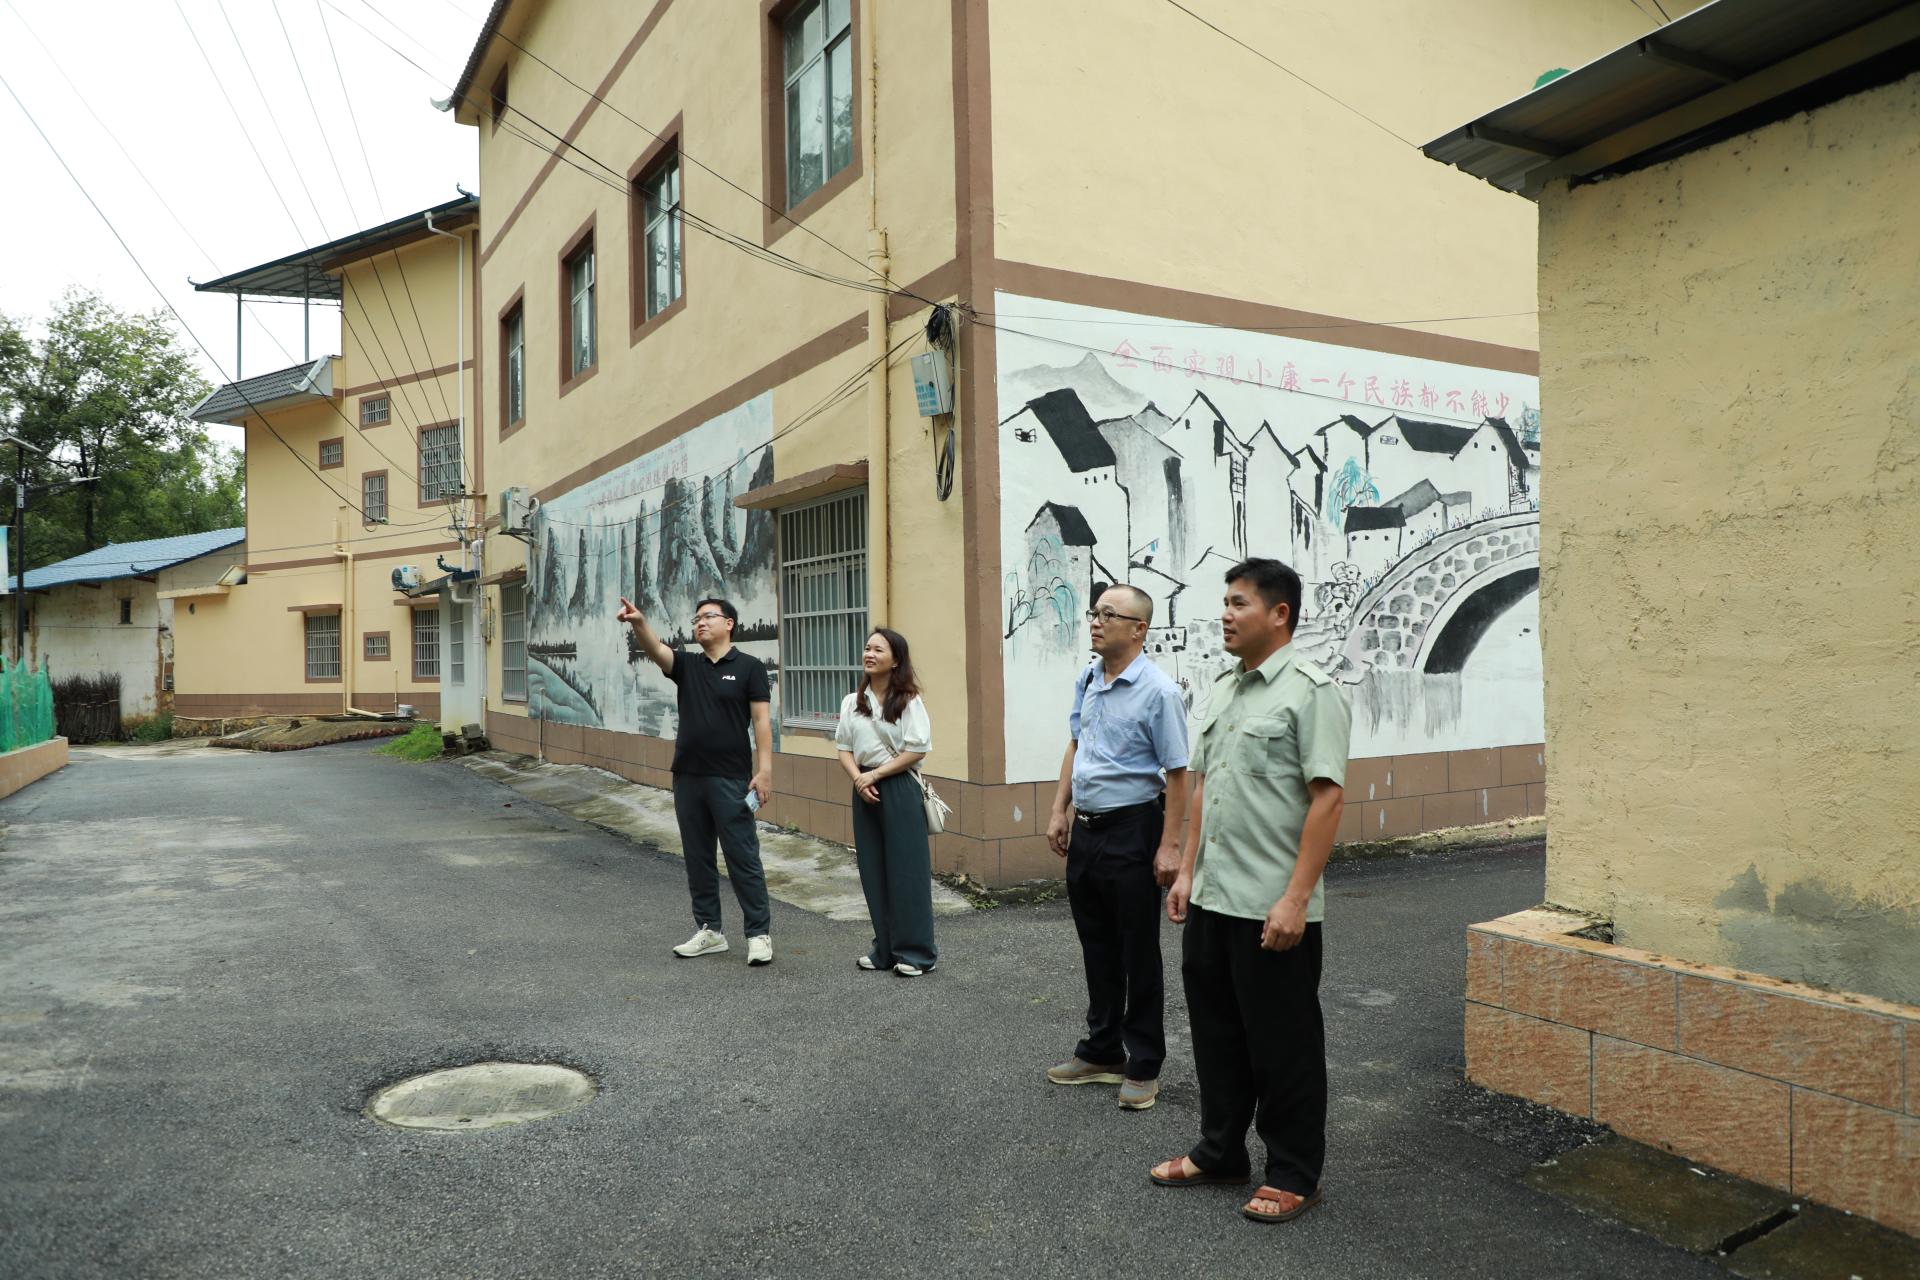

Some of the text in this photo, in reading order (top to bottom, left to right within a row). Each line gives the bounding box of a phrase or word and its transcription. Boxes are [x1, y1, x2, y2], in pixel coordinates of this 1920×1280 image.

[1111, 338, 1511, 418] 全面实现小康一个民族都不能少
